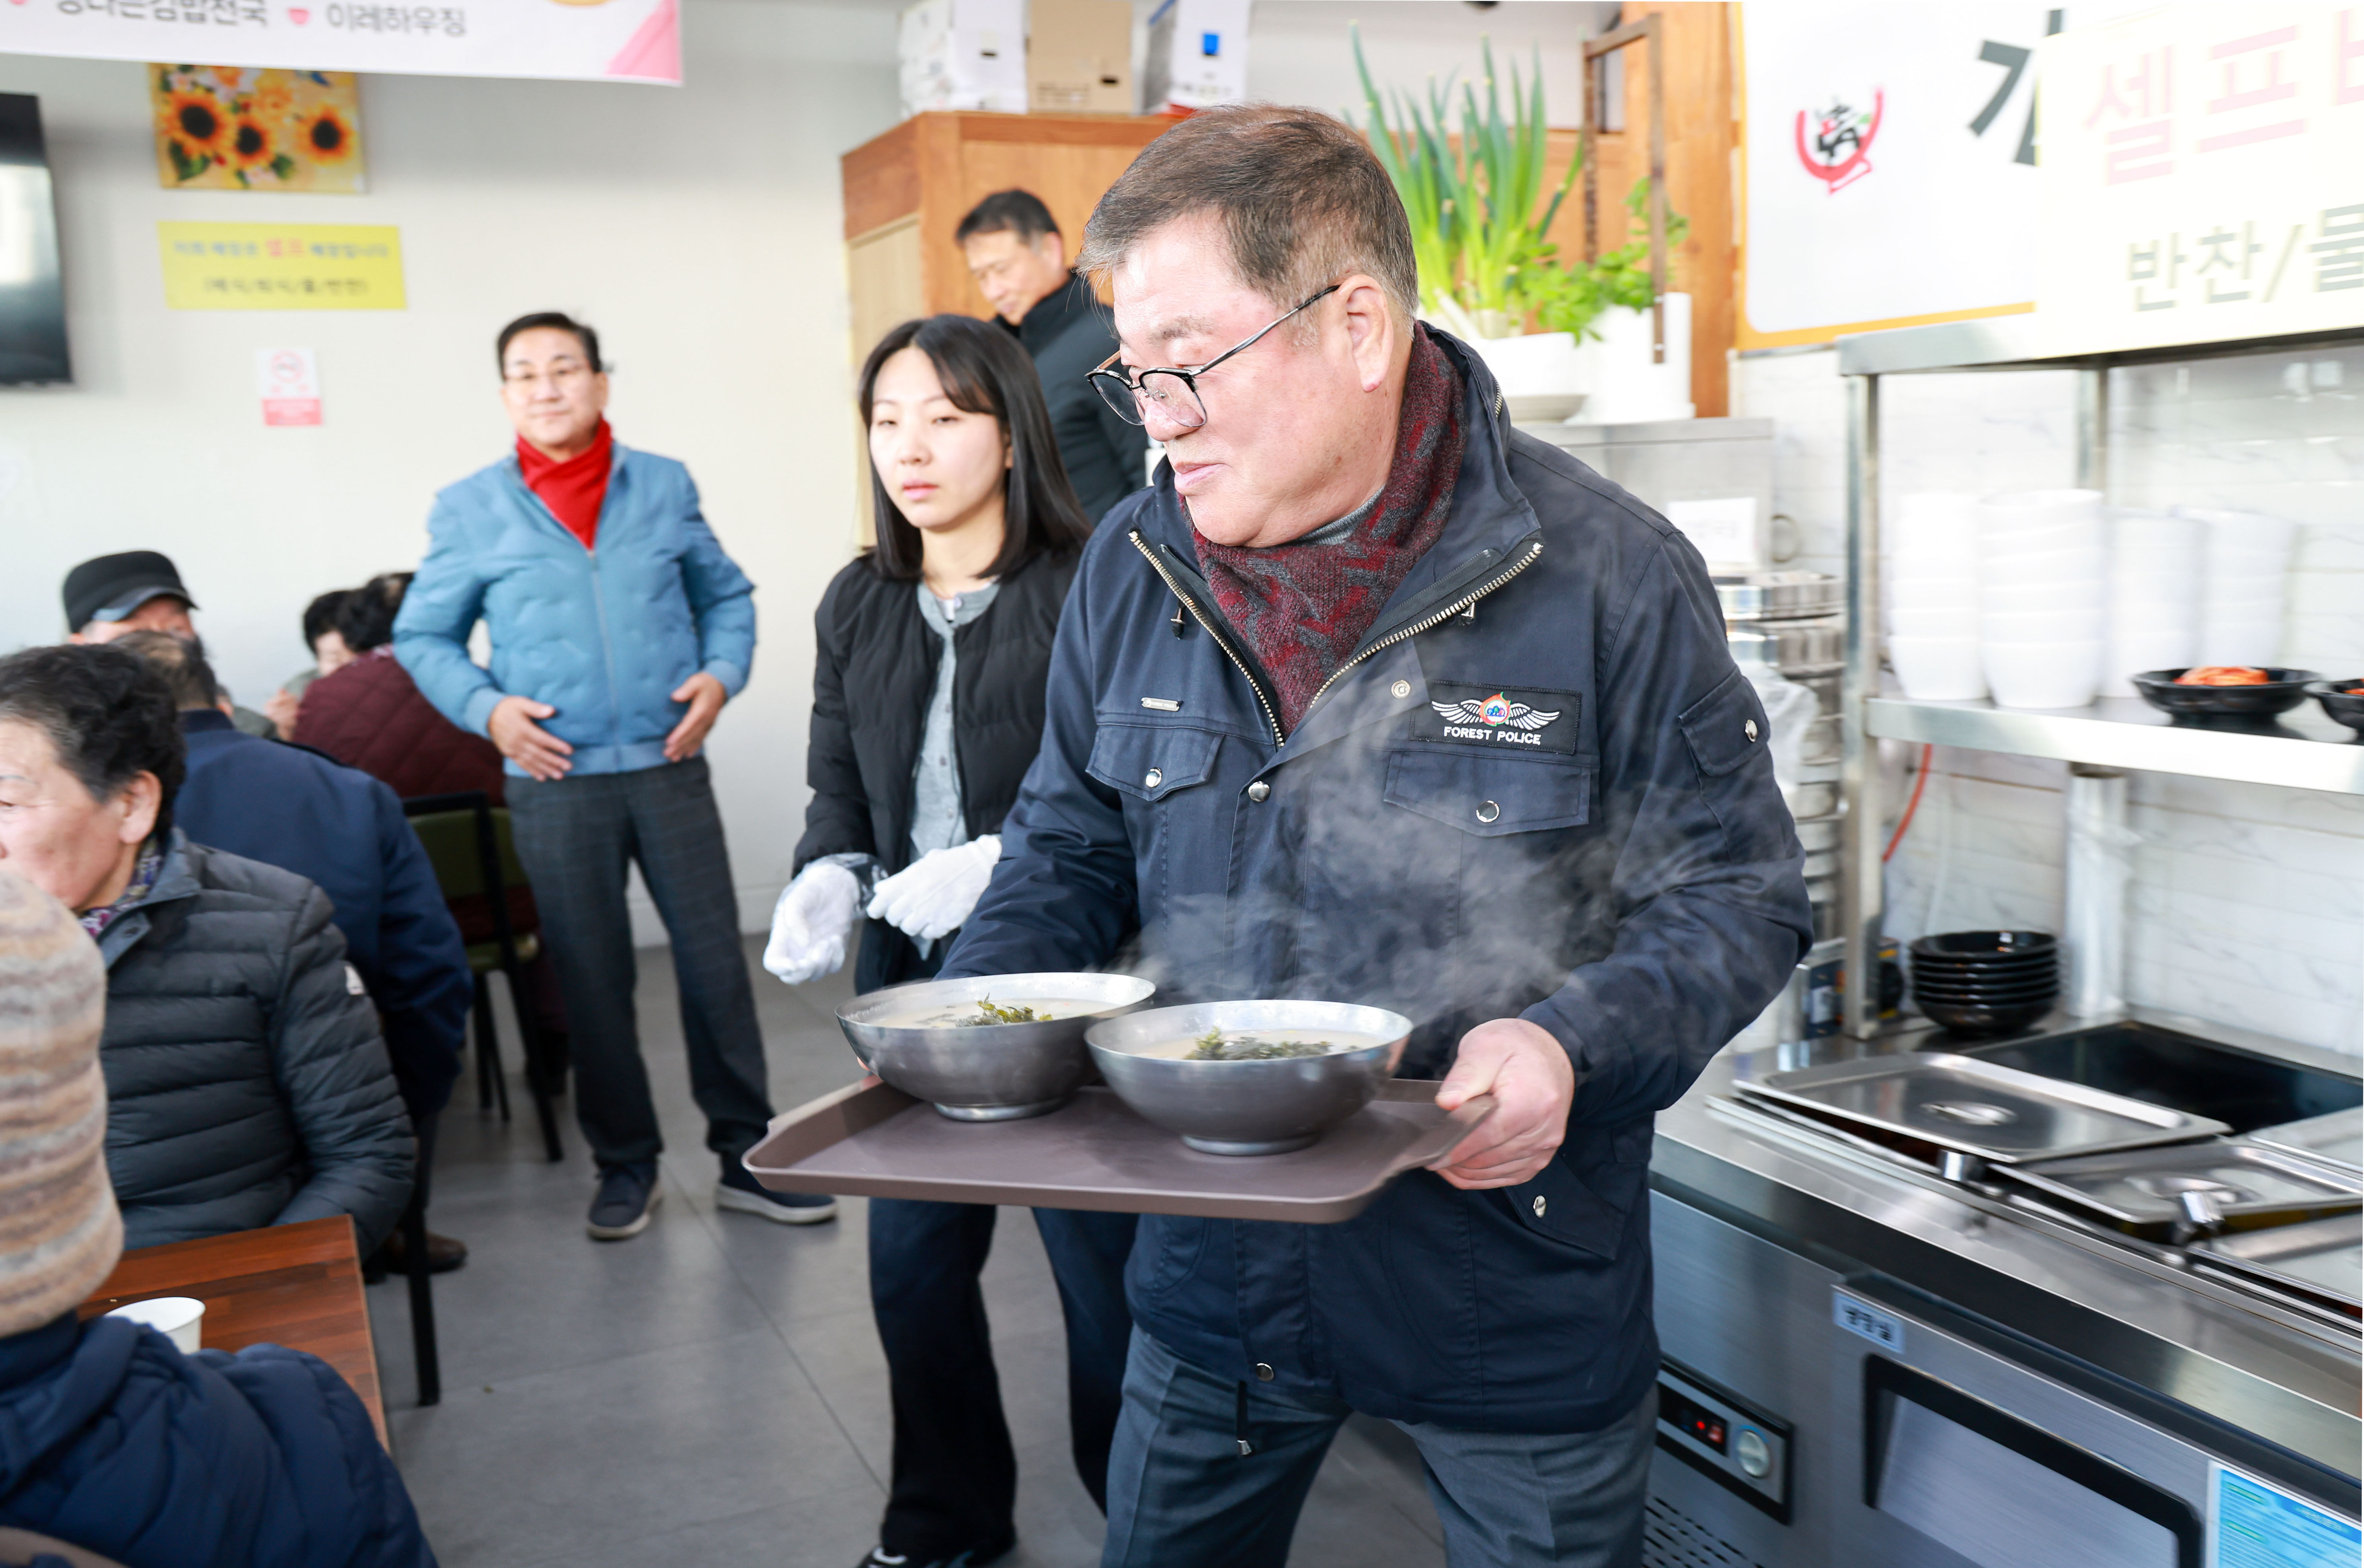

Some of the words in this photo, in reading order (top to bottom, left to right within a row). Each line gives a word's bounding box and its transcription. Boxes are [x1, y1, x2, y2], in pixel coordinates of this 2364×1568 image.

[327, 3, 465, 35] 이레하우징
[1443, 725, 1492, 740] FOREST
[1496, 731, 1541, 745] POLICE
